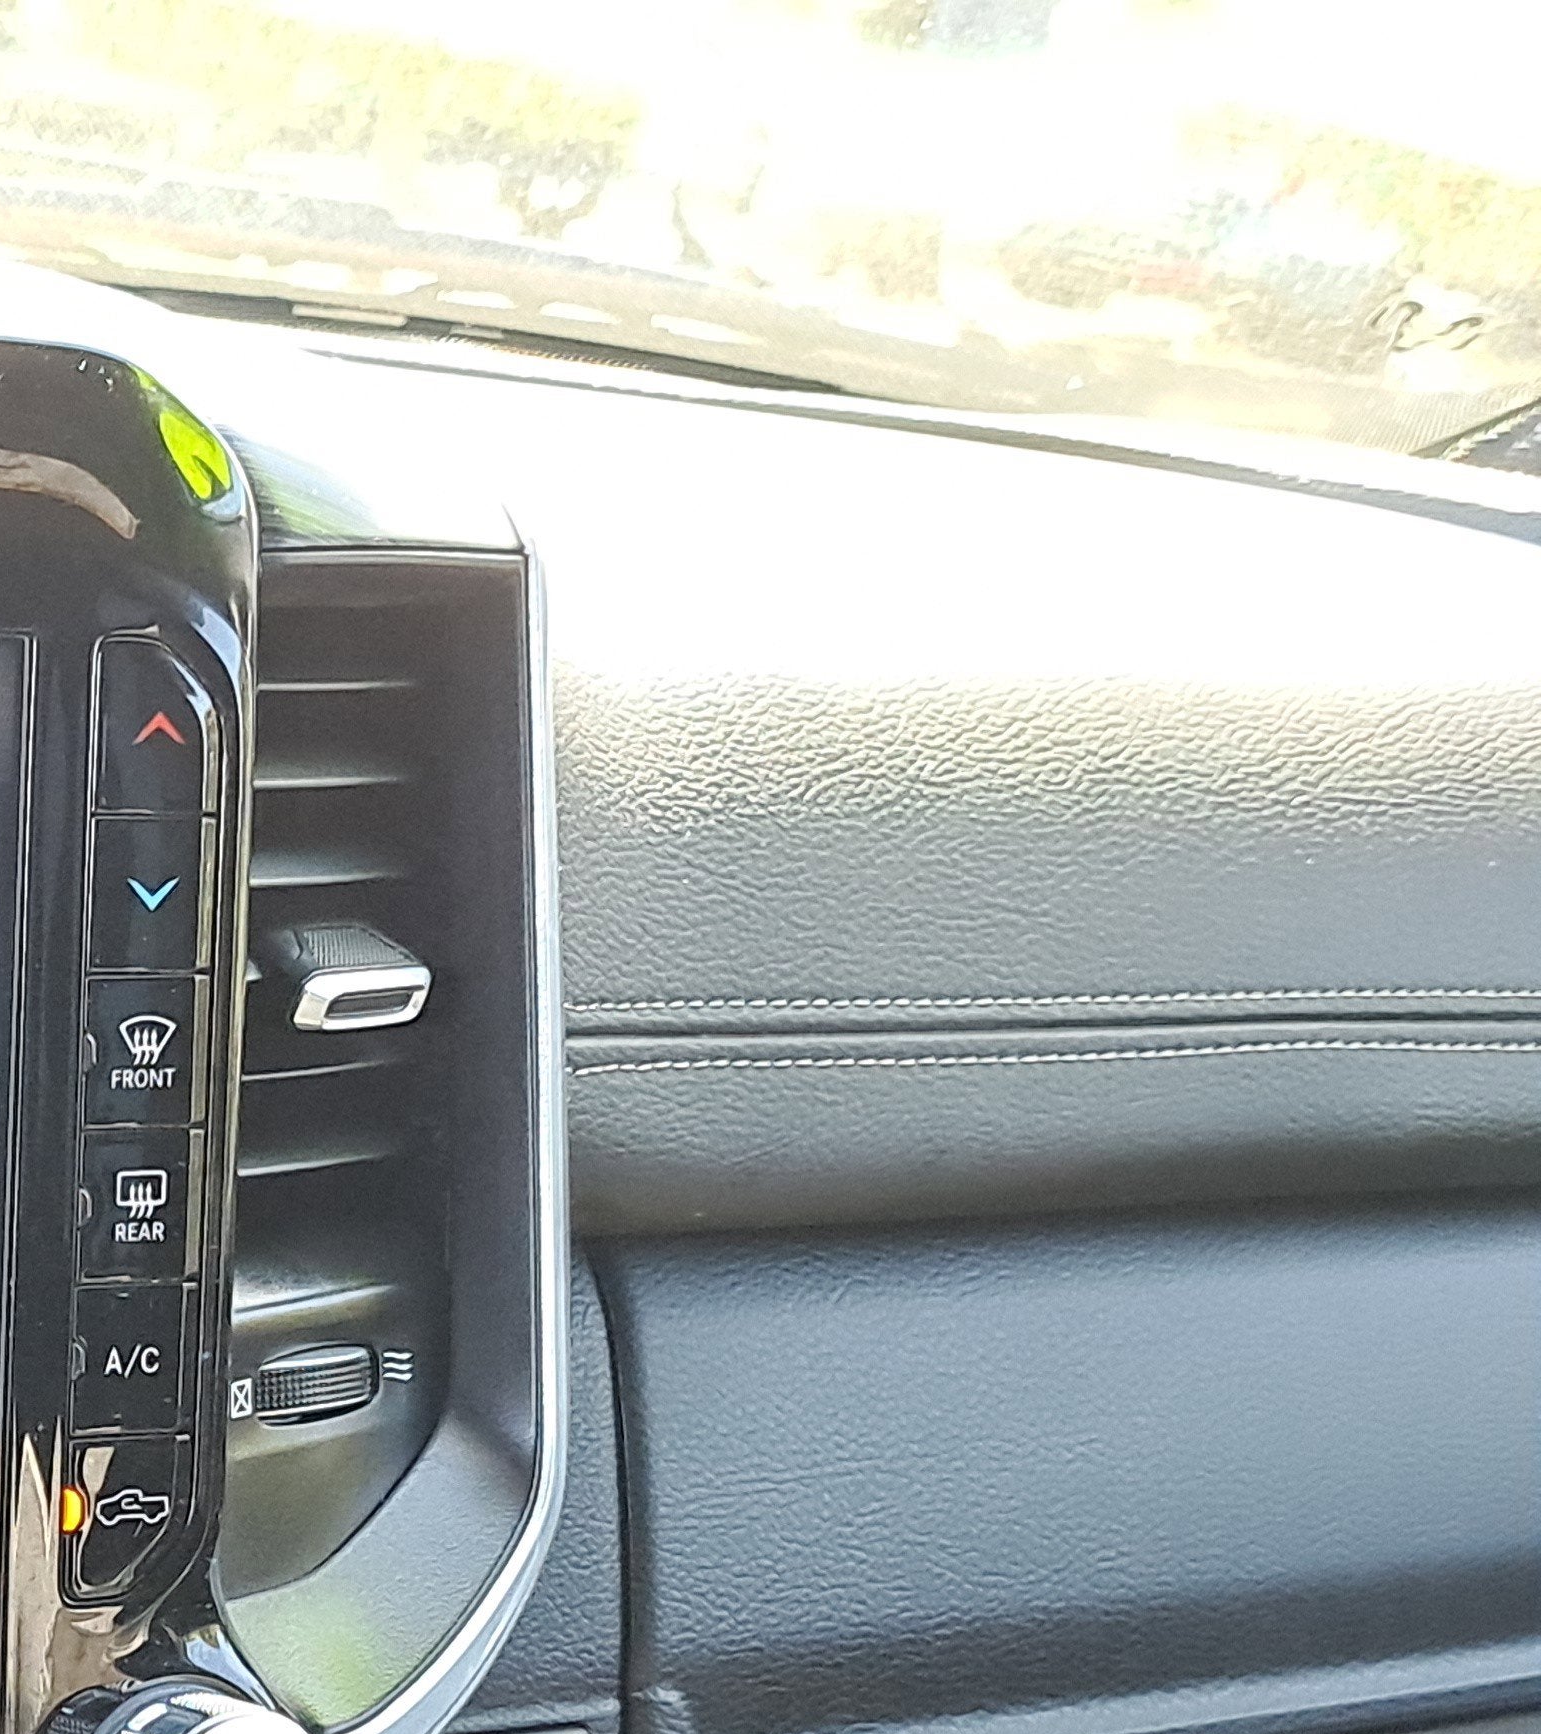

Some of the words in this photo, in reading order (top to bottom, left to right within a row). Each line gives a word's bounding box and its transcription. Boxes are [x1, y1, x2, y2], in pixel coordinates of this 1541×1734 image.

[110, 1067, 177, 1090] FRONT
[114, 1223, 166, 1243] REAR
[103, 1345, 161, 1377] A/C
